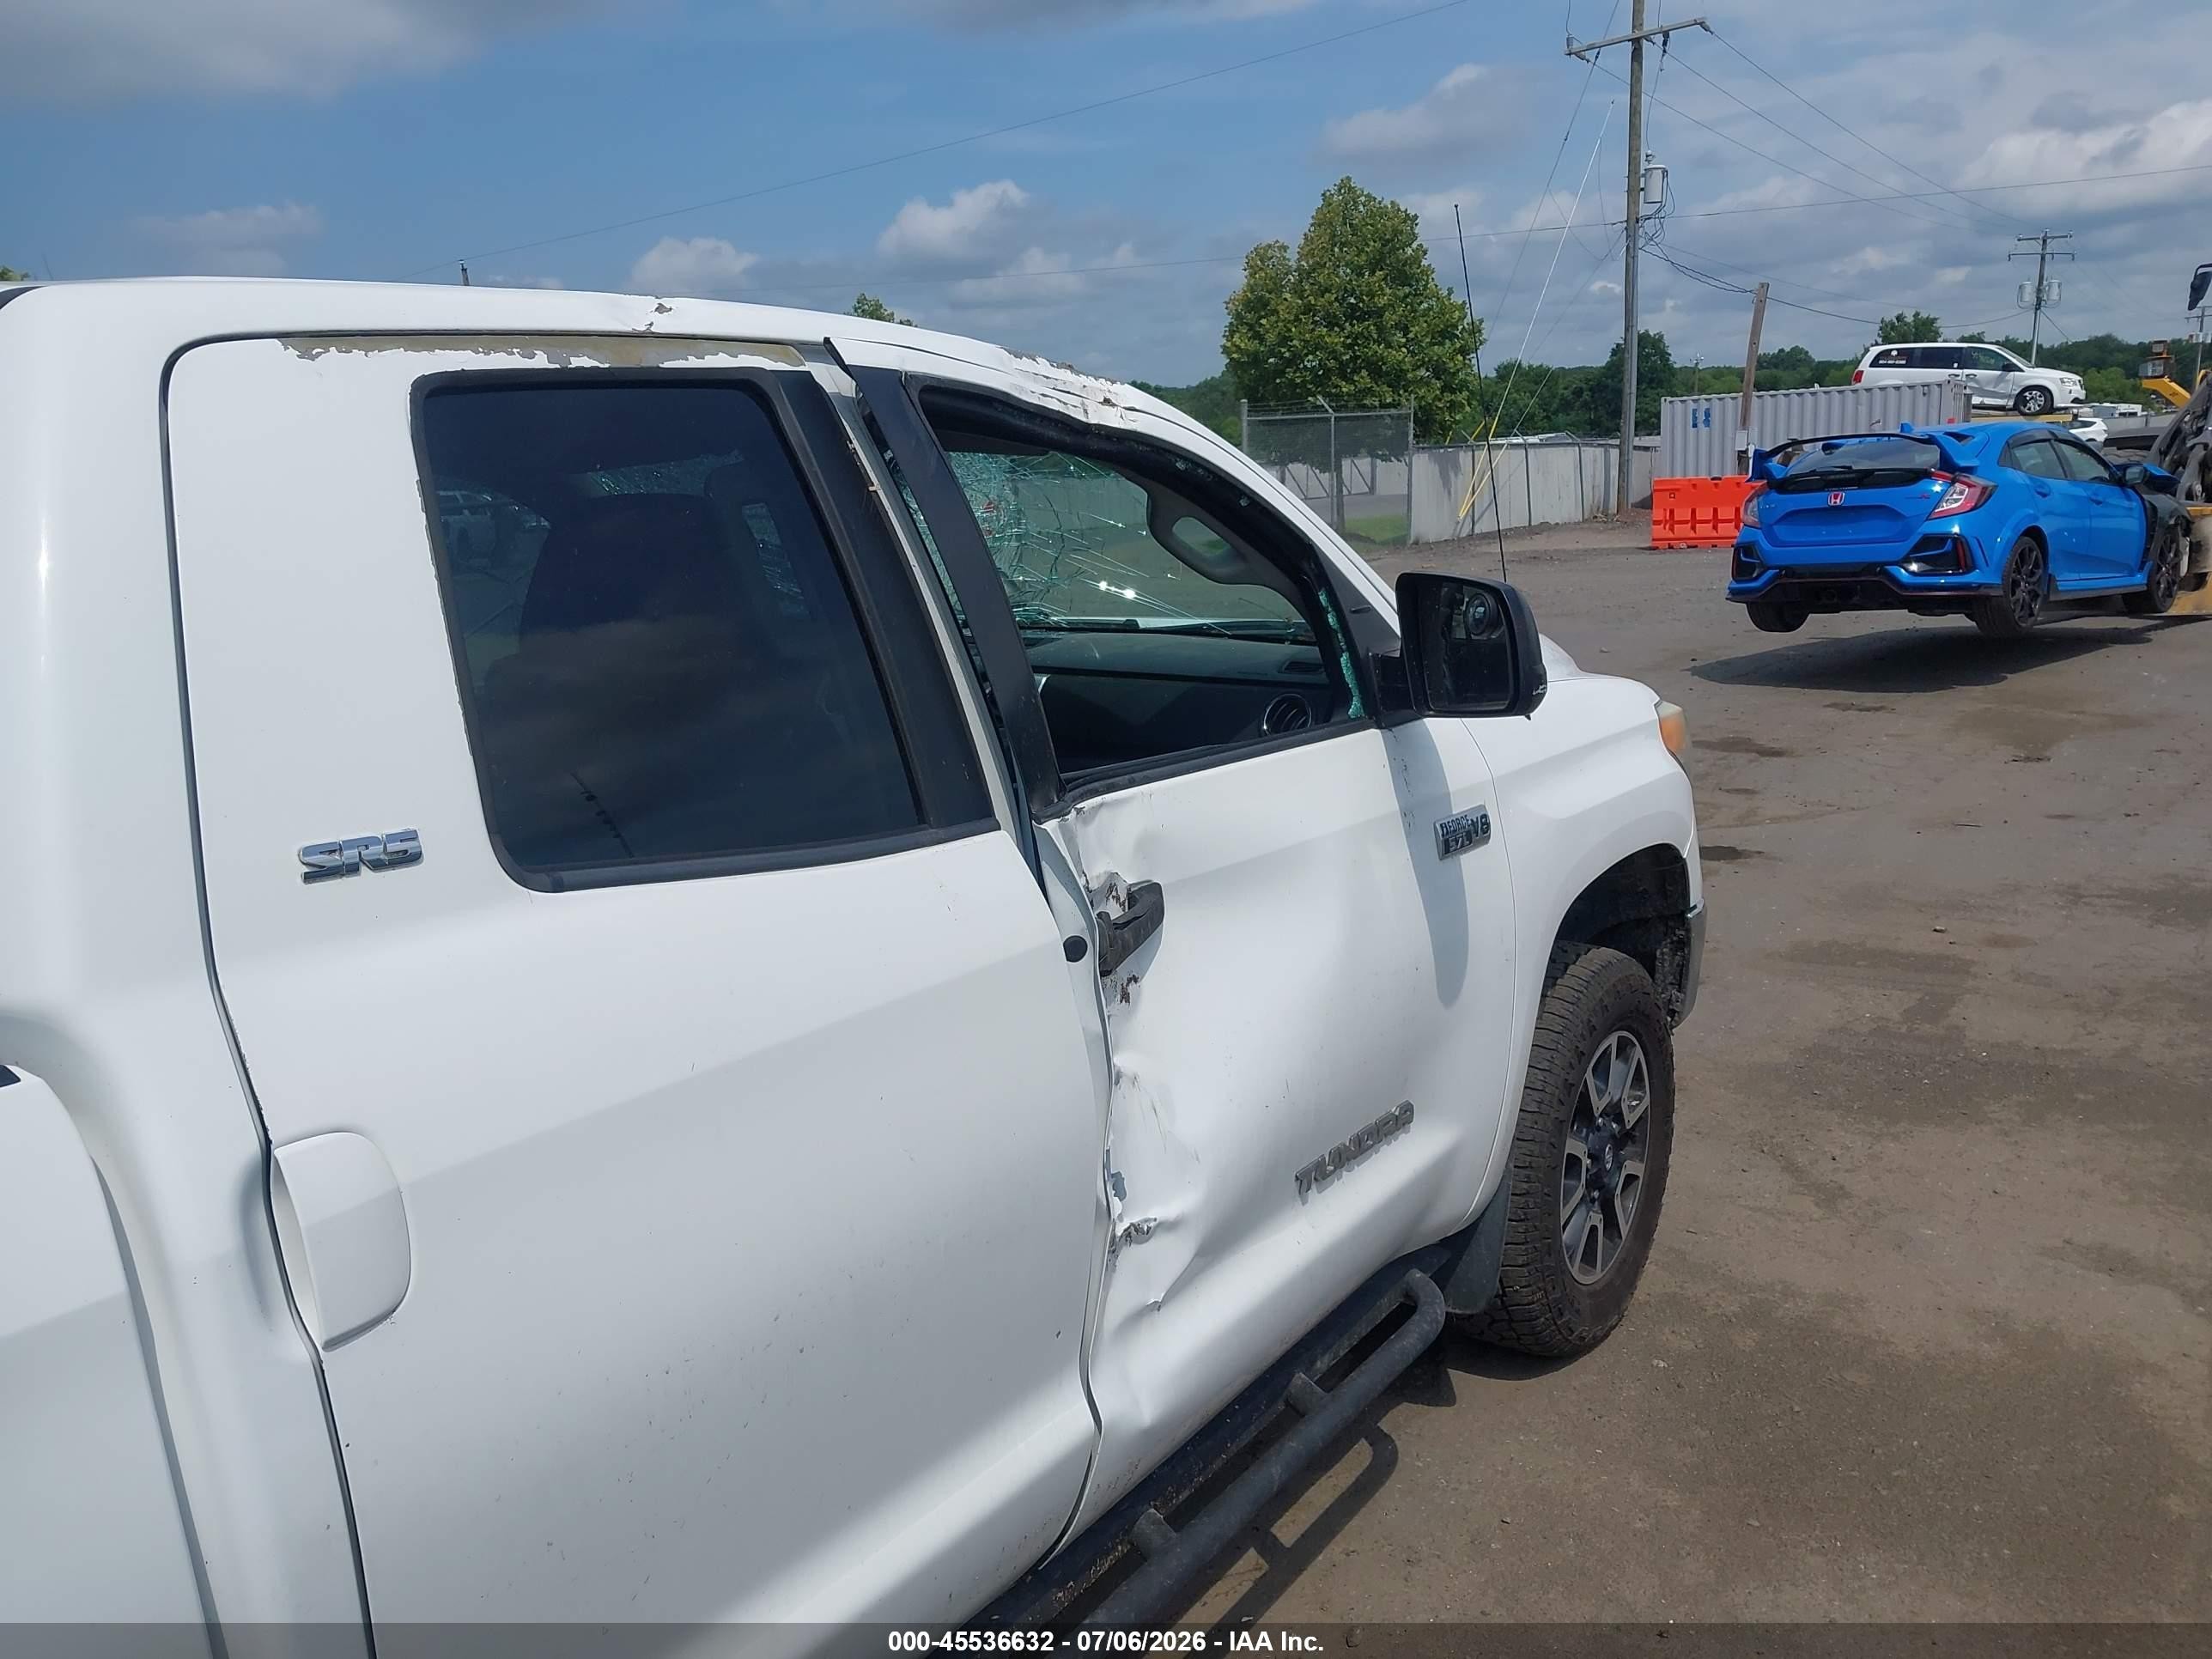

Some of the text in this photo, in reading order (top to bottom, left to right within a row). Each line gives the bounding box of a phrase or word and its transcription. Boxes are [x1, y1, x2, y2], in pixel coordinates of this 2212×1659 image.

[1470, 813, 1491, 837] V8
[299, 827, 425, 884] SR5
[1295, 1100, 1415, 1196] TUNDRA
